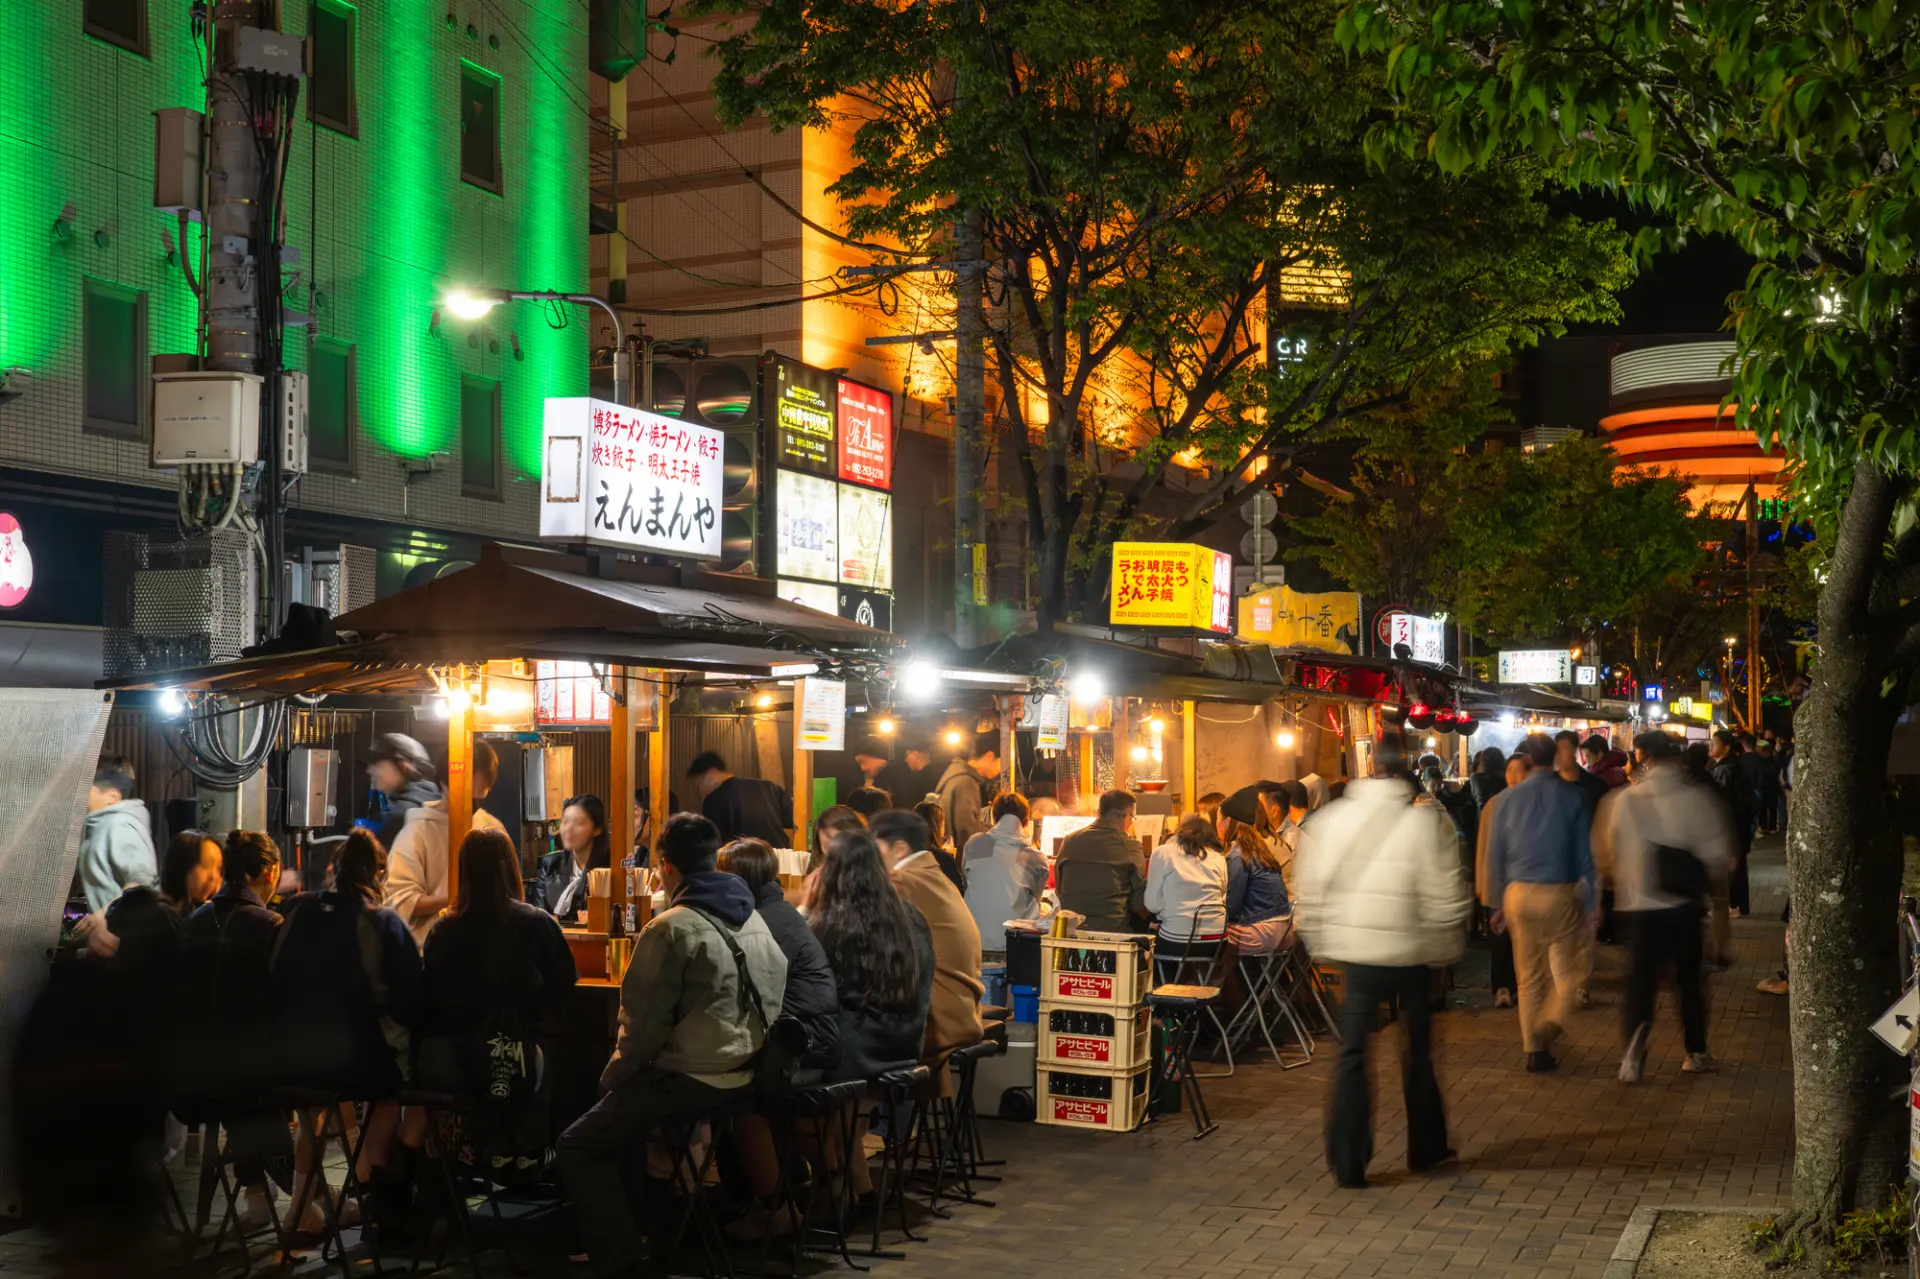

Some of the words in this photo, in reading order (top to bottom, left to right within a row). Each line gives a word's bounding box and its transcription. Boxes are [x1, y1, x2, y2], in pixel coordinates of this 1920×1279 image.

[594, 479, 715, 544] えんまんや
[1118, 560, 1131, 608] ラーメン
[1131, 560, 1146, 600] おでん
[1146, 560, 1159, 602] 明太子
[1161, 560, 1174, 602] 炭火焼
[1176, 561, 1189, 587] もつ
[1396, 618, 1408, 643] ラーメ
[1060, 977, 1111, 989] アサヒビール
[1057, 1038, 1108, 1052] アサヒビール
[1055, 1100, 1107, 1114] アサヒビール
